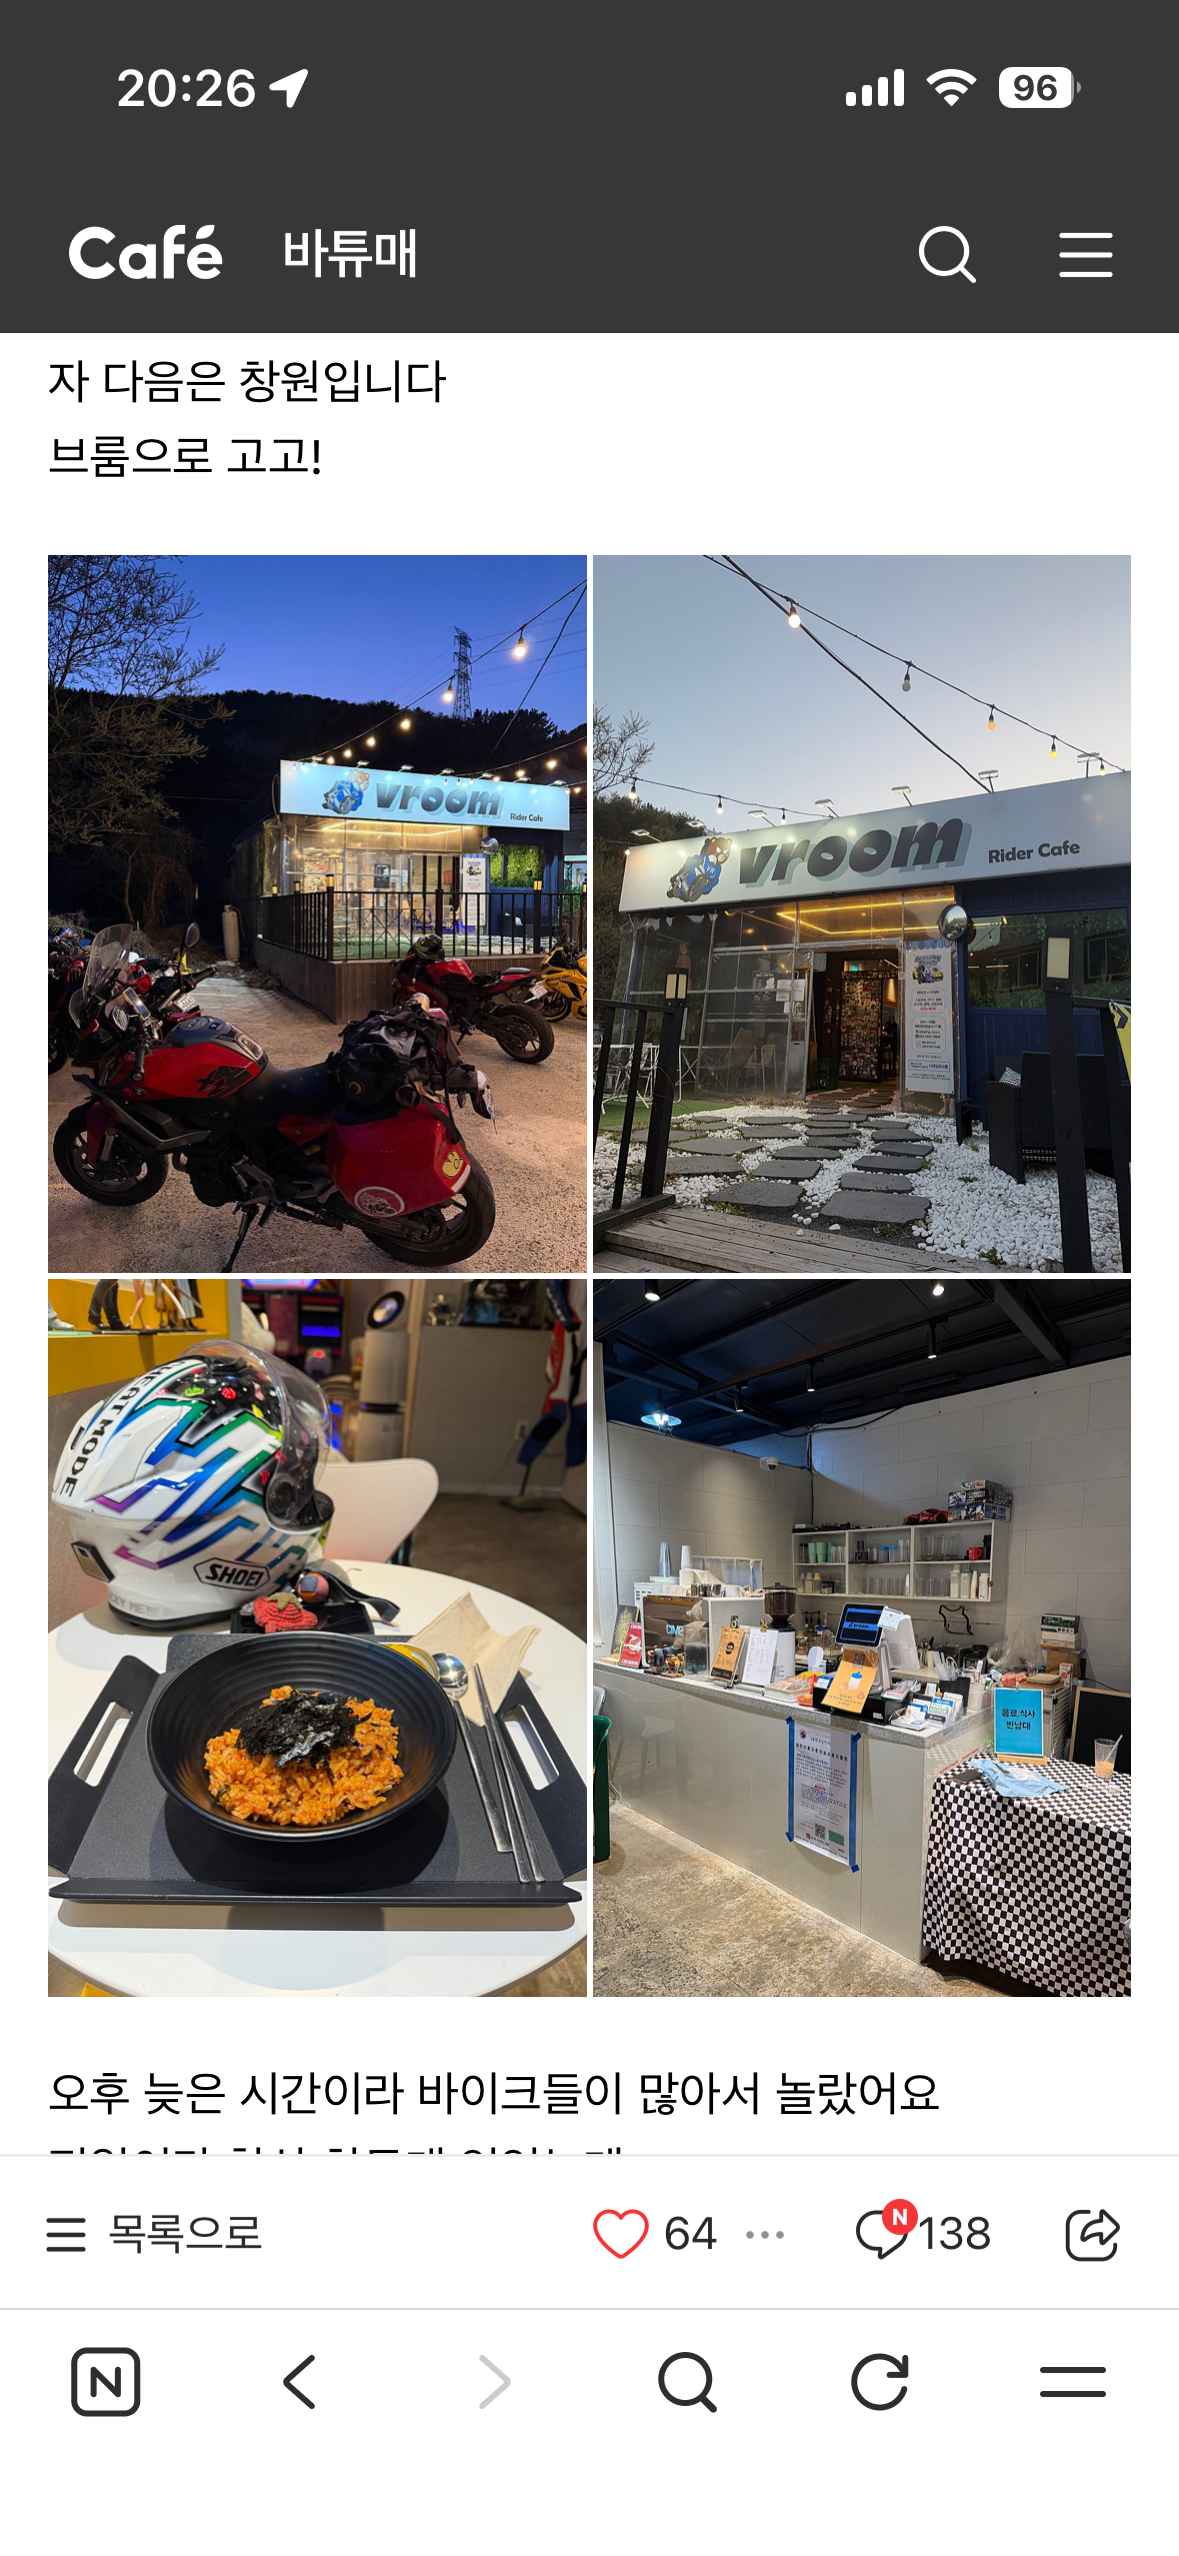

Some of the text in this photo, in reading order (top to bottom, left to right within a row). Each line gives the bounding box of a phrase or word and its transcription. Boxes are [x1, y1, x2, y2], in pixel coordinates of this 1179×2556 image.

[118, 69, 256, 108] 20:26
[1013, 73, 1058, 101] 96
[68, 224, 223, 280] Café
[284, 228, 416, 278] 바튜매
[48, 359, 447, 403] 자 다음은 창원입니다
[49, 436, 321, 478] 브룸으로 고고!
[376, 783, 502, 817] vroom
[510, 812, 543, 822] Rider Cafe
[739, 818, 968, 886] vroom
[988, 842, 1081, 864] Rider Cafe
[60, 1361, 186, 1498] CHEAT MODE
[205, 1563, 265, 1588] SHOEI
[1006, 1721, 1031, 1730] 반납대
[49, 2071, 940, 2116] 오후 늦은 시간이라 바이크들이 많아서 놀랐어요
[109, 2214, 262, 2254] 목록으로
[665, 2216, 717, 2251] 64
[892, 2208, 908, 2226] N
[919, 2216, 991, 2250] 138
